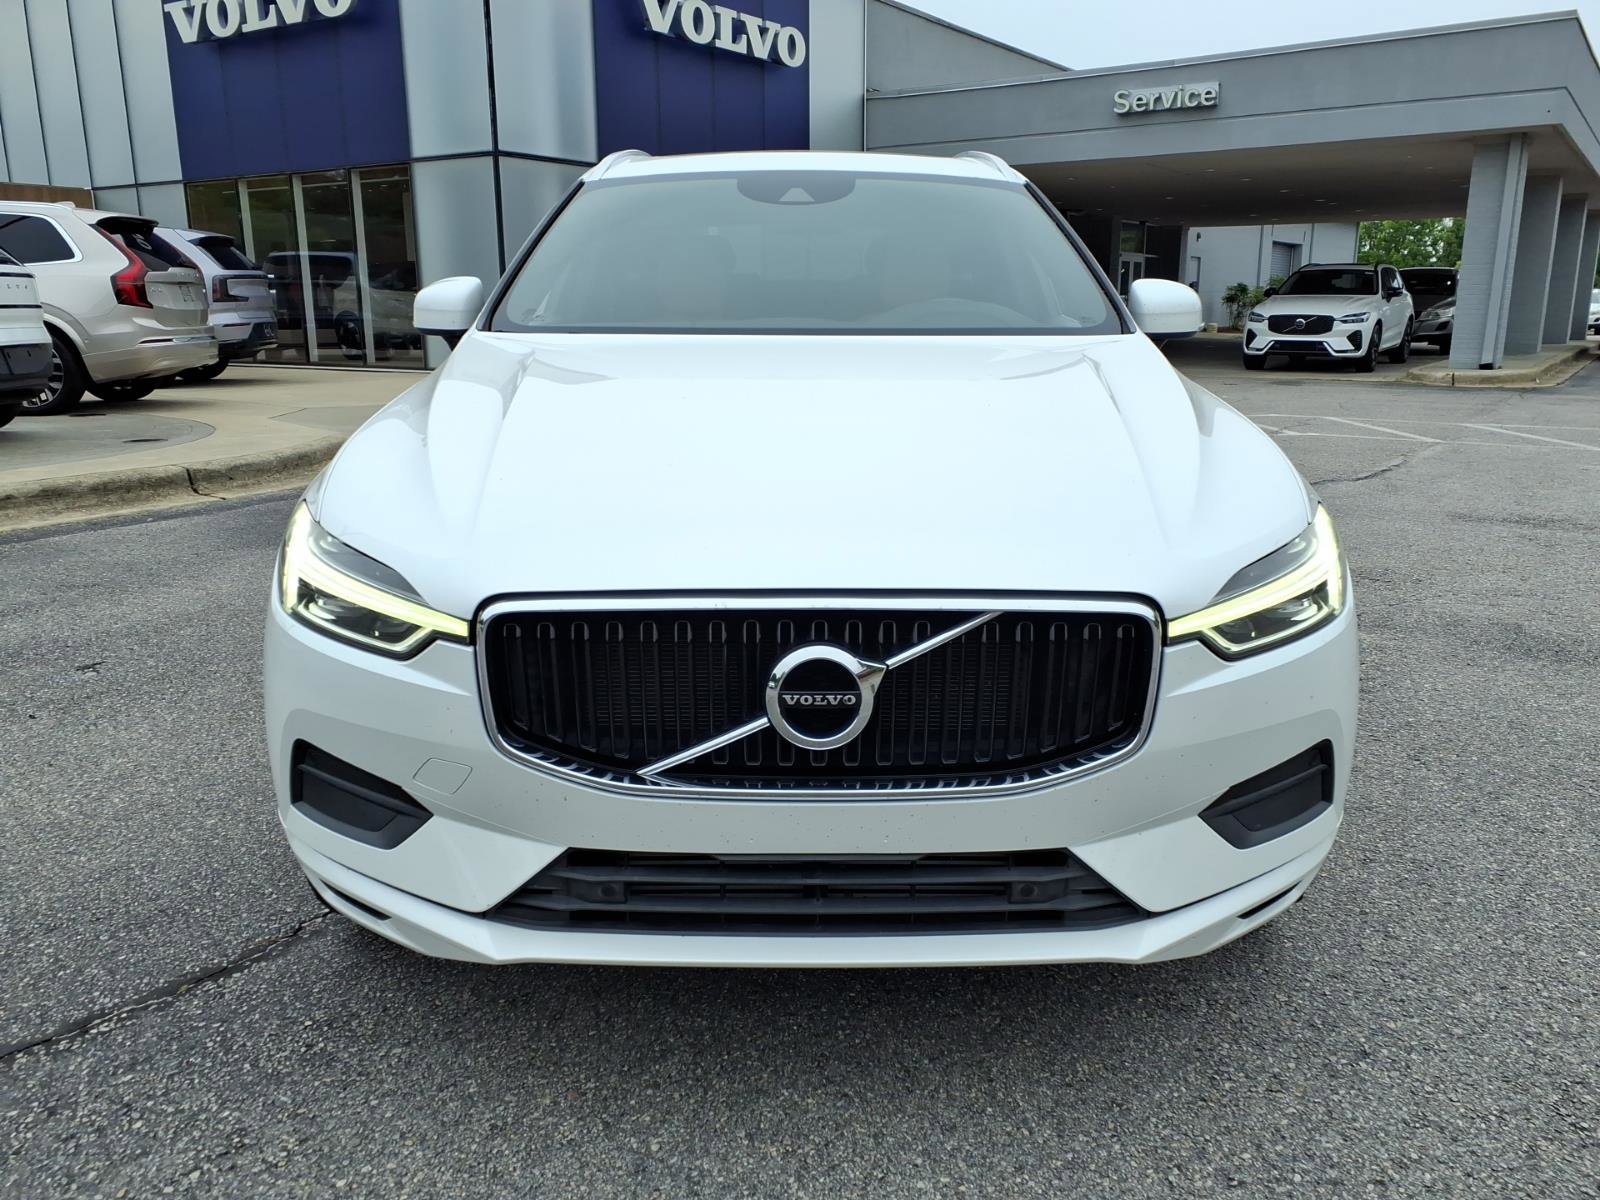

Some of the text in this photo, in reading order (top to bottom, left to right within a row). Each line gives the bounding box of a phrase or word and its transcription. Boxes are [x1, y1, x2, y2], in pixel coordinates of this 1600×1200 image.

[643, 0, 806, 67] VOLVO
[1113, 84, 1217, 113] Service
[782, 694, 856, 705] VOLVO
